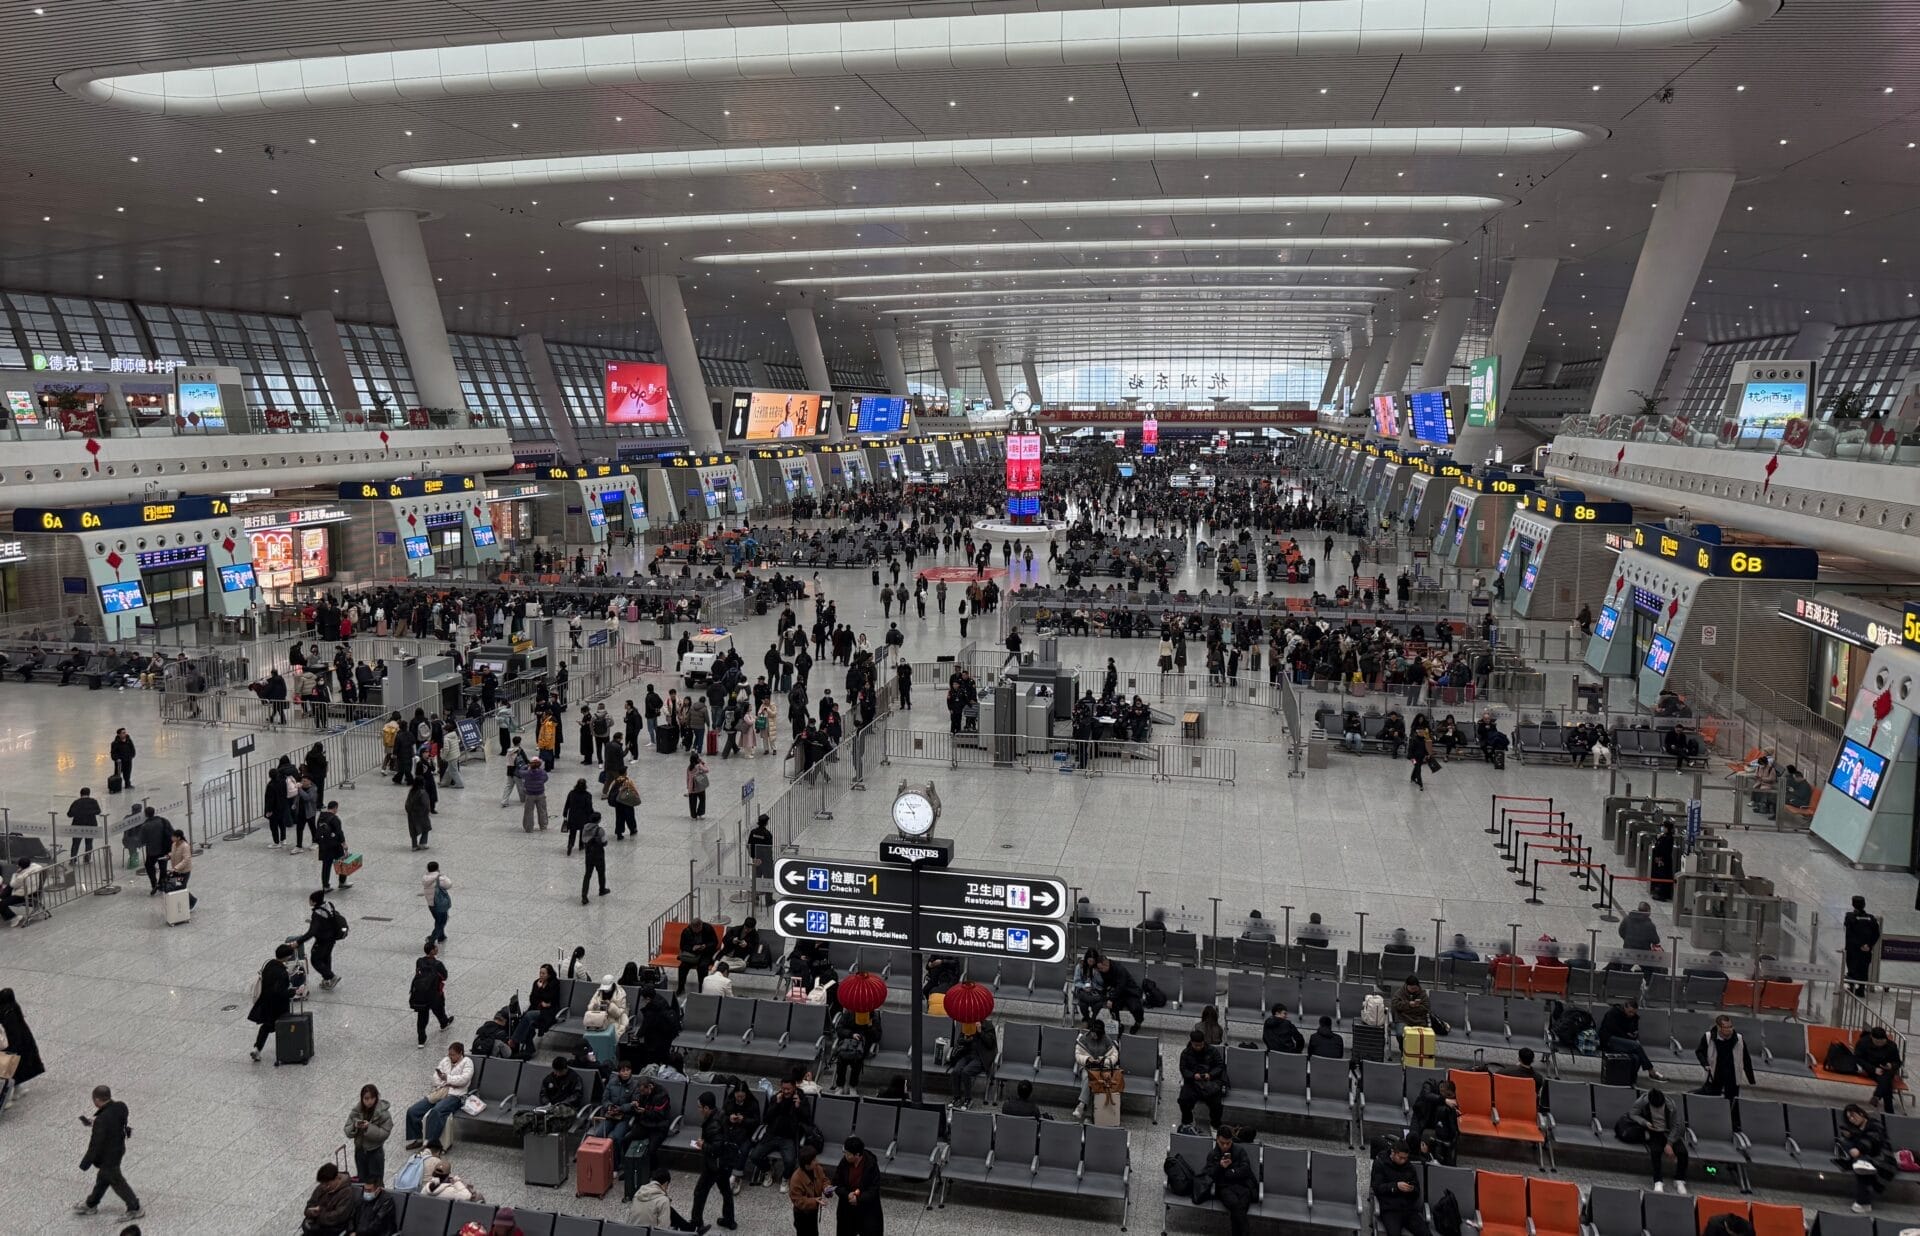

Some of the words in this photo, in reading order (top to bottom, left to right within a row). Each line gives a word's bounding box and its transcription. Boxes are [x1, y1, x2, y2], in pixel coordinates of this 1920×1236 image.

[48, 354, 93, 371] 德克士
[673, 458, 689, 467] 12A
[549, 468, 568, 479] 10A
[1441, 467, 1461, 476] 12B
[362, 484, 378, 497] 8A
[390, 485, 402, 496] 8A
[463, 478, 474, 489] 9A
[1491, 481, 1516, 493] 10B
[212, 500, 228, 514] 7A
[1574, 506, 1596, 520] 8B
[43, 512, 63, 529] 6A
[82, 511, 101, 528] 6A
[1635, 529, 1644, 546] 7B
[1698, 548, 1709, 568] 6B
[1731, 552, 1762, 572] 6B
[1805, 601, 1839, 628] 西湖龙井
[888, 846, 939, 858] LONGINES
[830, 871, 866, 885] 检票口
[868, 874, 878, 895] 1
[830, 884, 852, 893] Check
[966, 883, 1004, 898] 卫生间
[965, 896, 1004, 906] Restrooms
[830, 913, 884, 930] 重点旅客
[830, 926, 860, 936] Passengers
[872, 930, 891, 939] Special
[963, 925, 1004, 941] 商务座
[958, 939, 986, 948] Business
[986, 941, 1004, 949] Class
